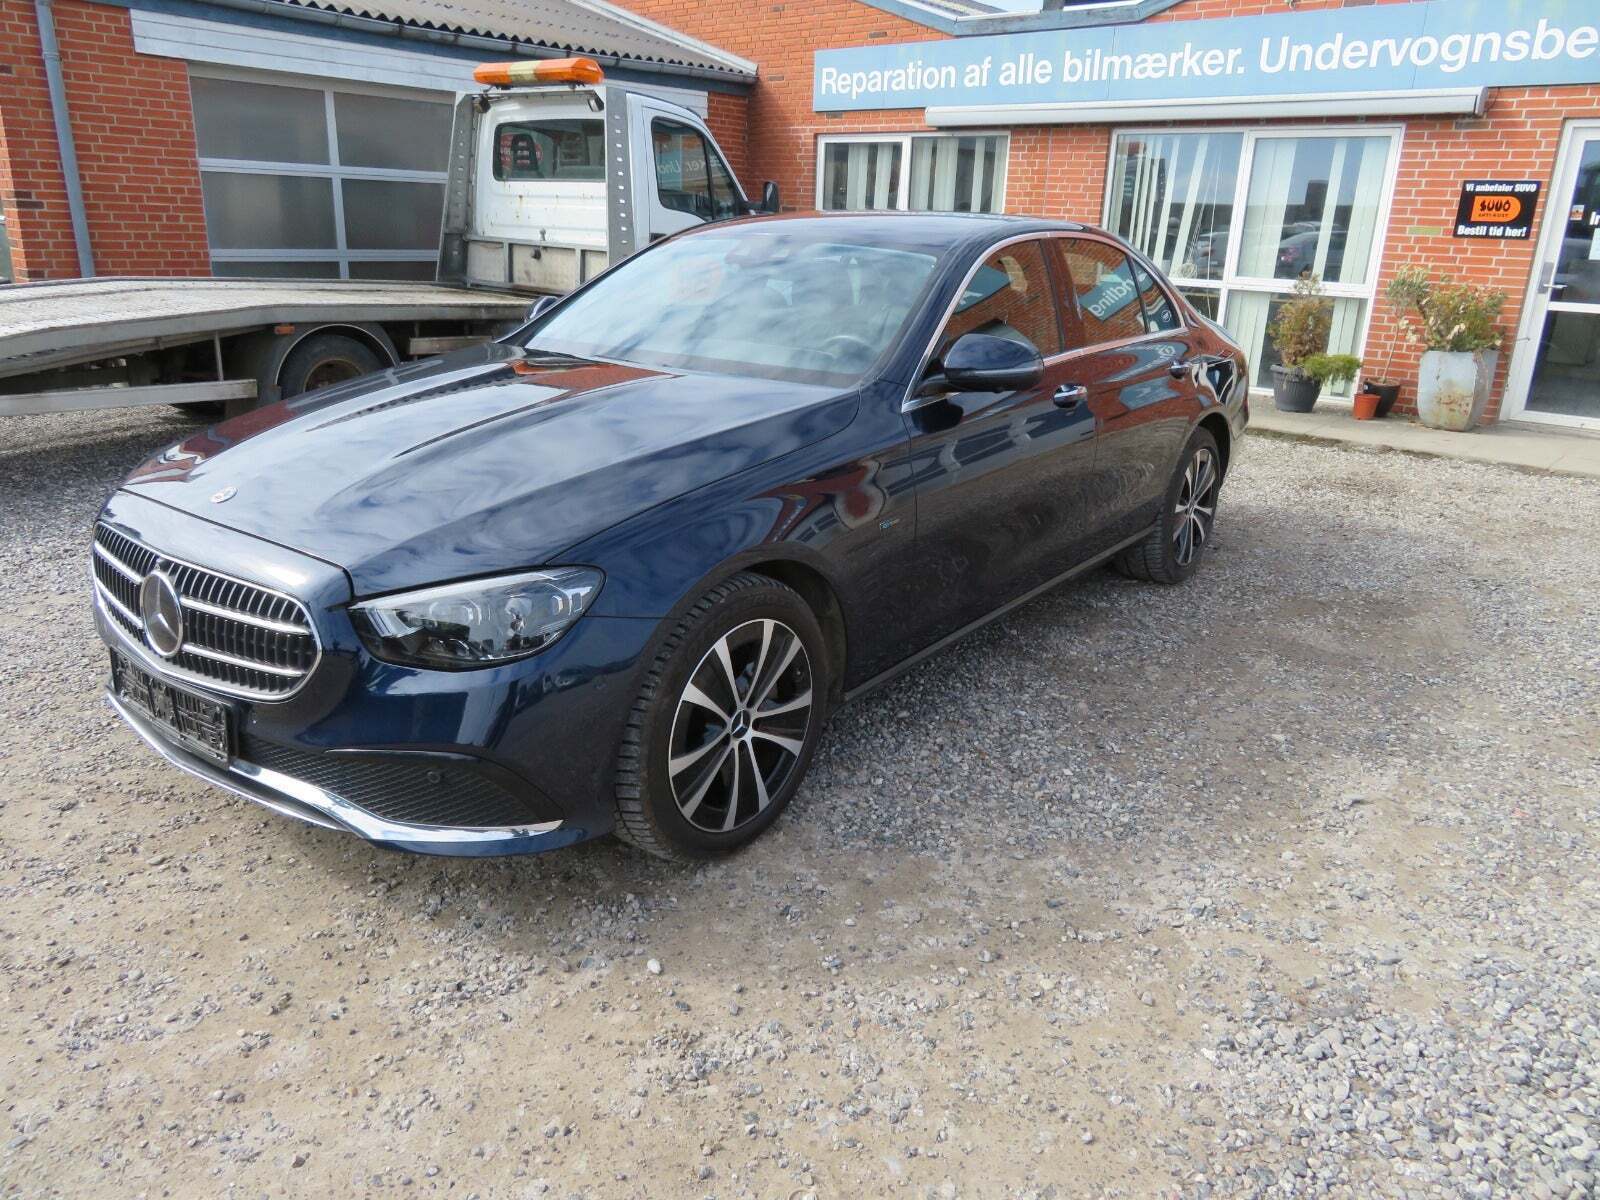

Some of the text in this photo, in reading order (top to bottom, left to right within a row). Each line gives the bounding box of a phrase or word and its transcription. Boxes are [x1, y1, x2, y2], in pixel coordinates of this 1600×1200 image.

[821, 18, 1600, 100] Reparation af alle bilmærker. Undervognsbe
[1465, 183, 1537, 192] Vi anbefaler SUVO
[1457, 224, 1527, 237] Bestil tid her!
